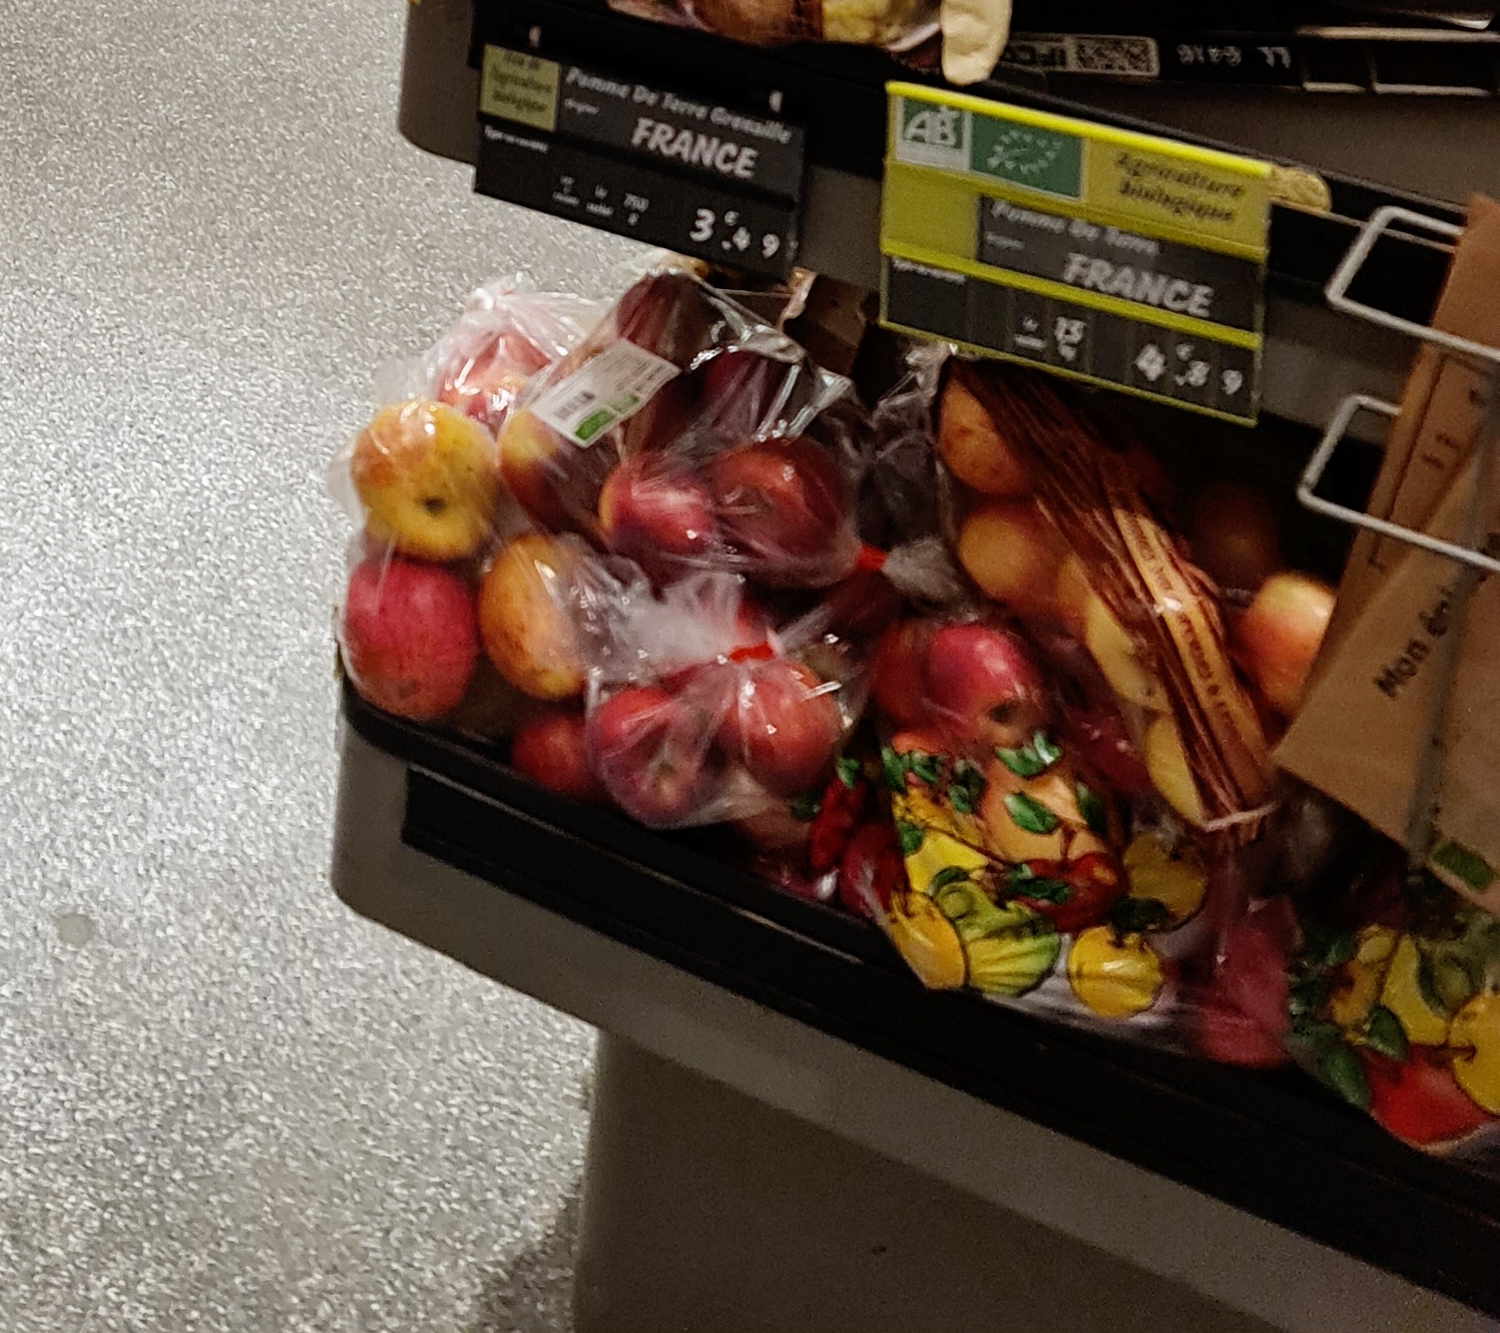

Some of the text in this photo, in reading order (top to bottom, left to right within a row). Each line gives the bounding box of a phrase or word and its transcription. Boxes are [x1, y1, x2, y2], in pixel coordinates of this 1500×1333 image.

[631, 116, 760, 180] FRANCE
[904, 109, 958, 147] AB
[1063, 251, 1215, 318] FRANCE
